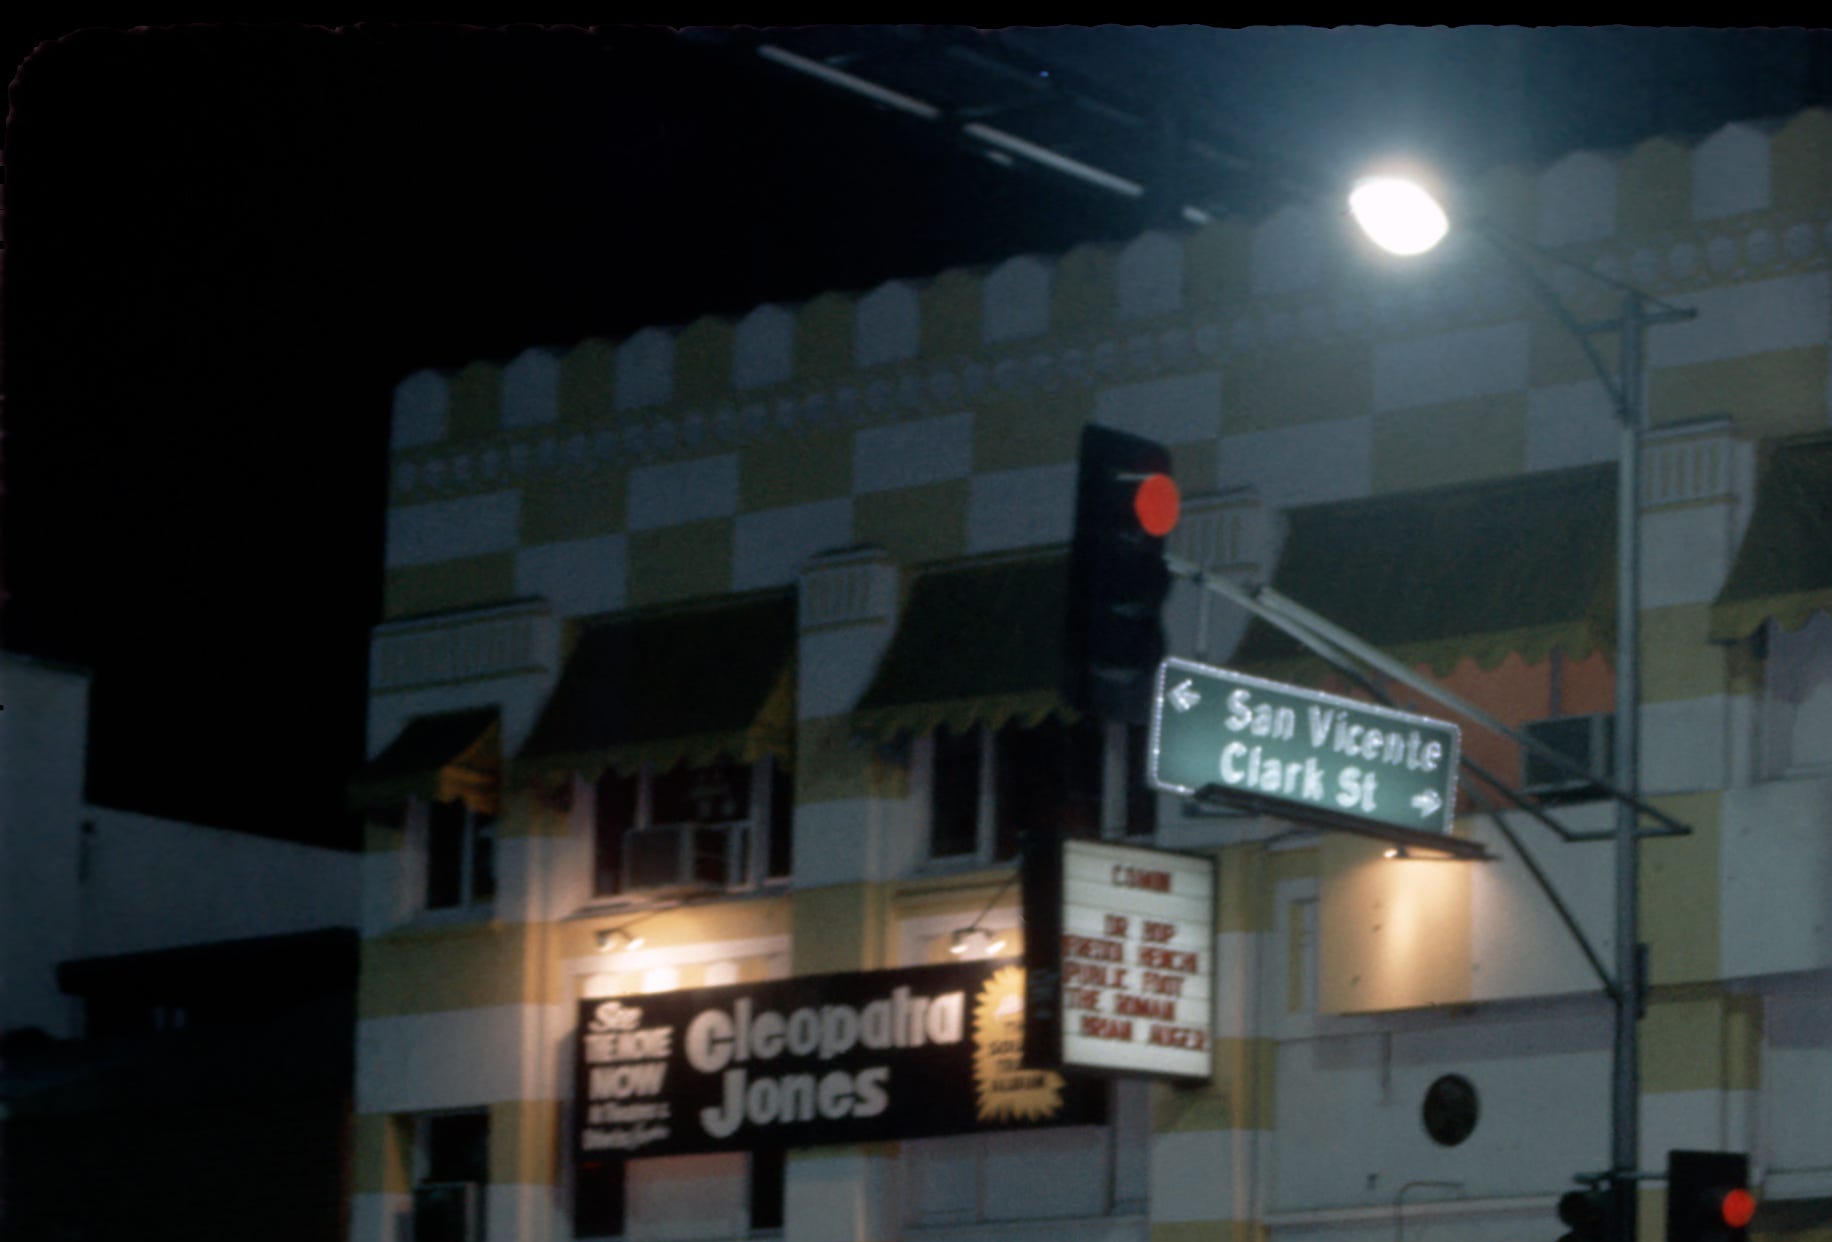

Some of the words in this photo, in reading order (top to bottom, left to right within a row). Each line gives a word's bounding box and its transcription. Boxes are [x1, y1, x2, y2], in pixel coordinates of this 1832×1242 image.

[1225, 689, 1295, 741] San
[1308, 705, 1442, 772] Vicente
[1219, 741, 1325, 801] Clark
[1336, 766, 1378, 813] St
[685, 987, 965, 1074] Cleopatra
[701, 1067, 889, 1138] Jones
